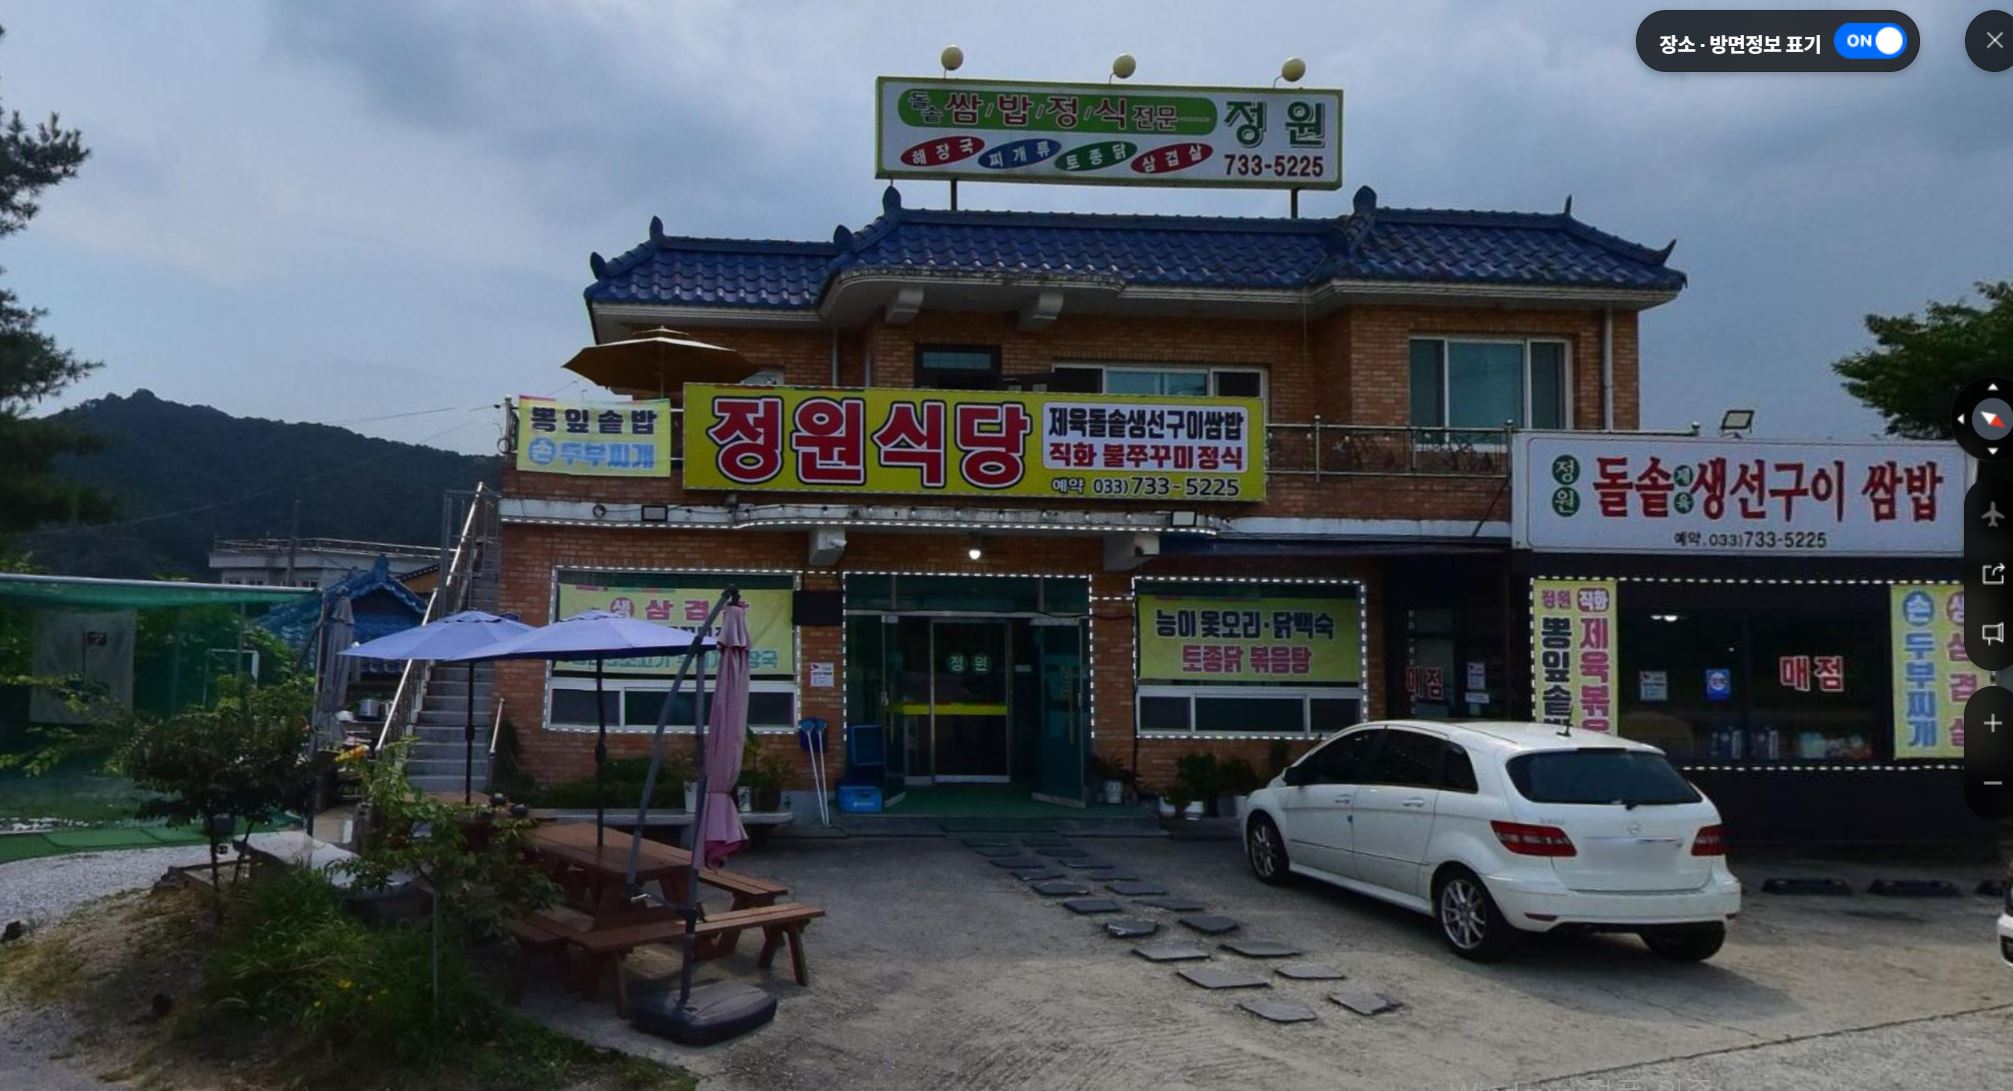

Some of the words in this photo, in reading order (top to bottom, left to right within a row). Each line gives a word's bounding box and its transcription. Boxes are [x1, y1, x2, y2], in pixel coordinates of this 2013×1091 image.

[1132, 105, 1177, 132] 전문
[911, 138, 976, 165] 해장국
[988, 140, 1052, 168] 찌개류
[1065, 144, 1126, 170] 토종닭
[1141, 145, 1203, 173] 삼겹살
[1224, 153, 1325, 178] 733-5225
[708, 396, 1030, 488] 정원식당
[1049, 442, 1096, 468] 직화
[1052, 476, 1085, 494] 예약
[1553, 456, 1580, 516] 정원
[1690, 456, 1845, 522] 생선구이
[1861, 460, 1944, 522] 쌈밥
[1541, 589, 1571, 610] 정원
[1577, 589, 1610, 612] 직화
[948, 655, 990, 673] 정원
[1182, 644, 1245, 674] 토종닭
[1249, 645, 1313, 675] 볶음탕
[1779, 655, 1844, 692] 매점
